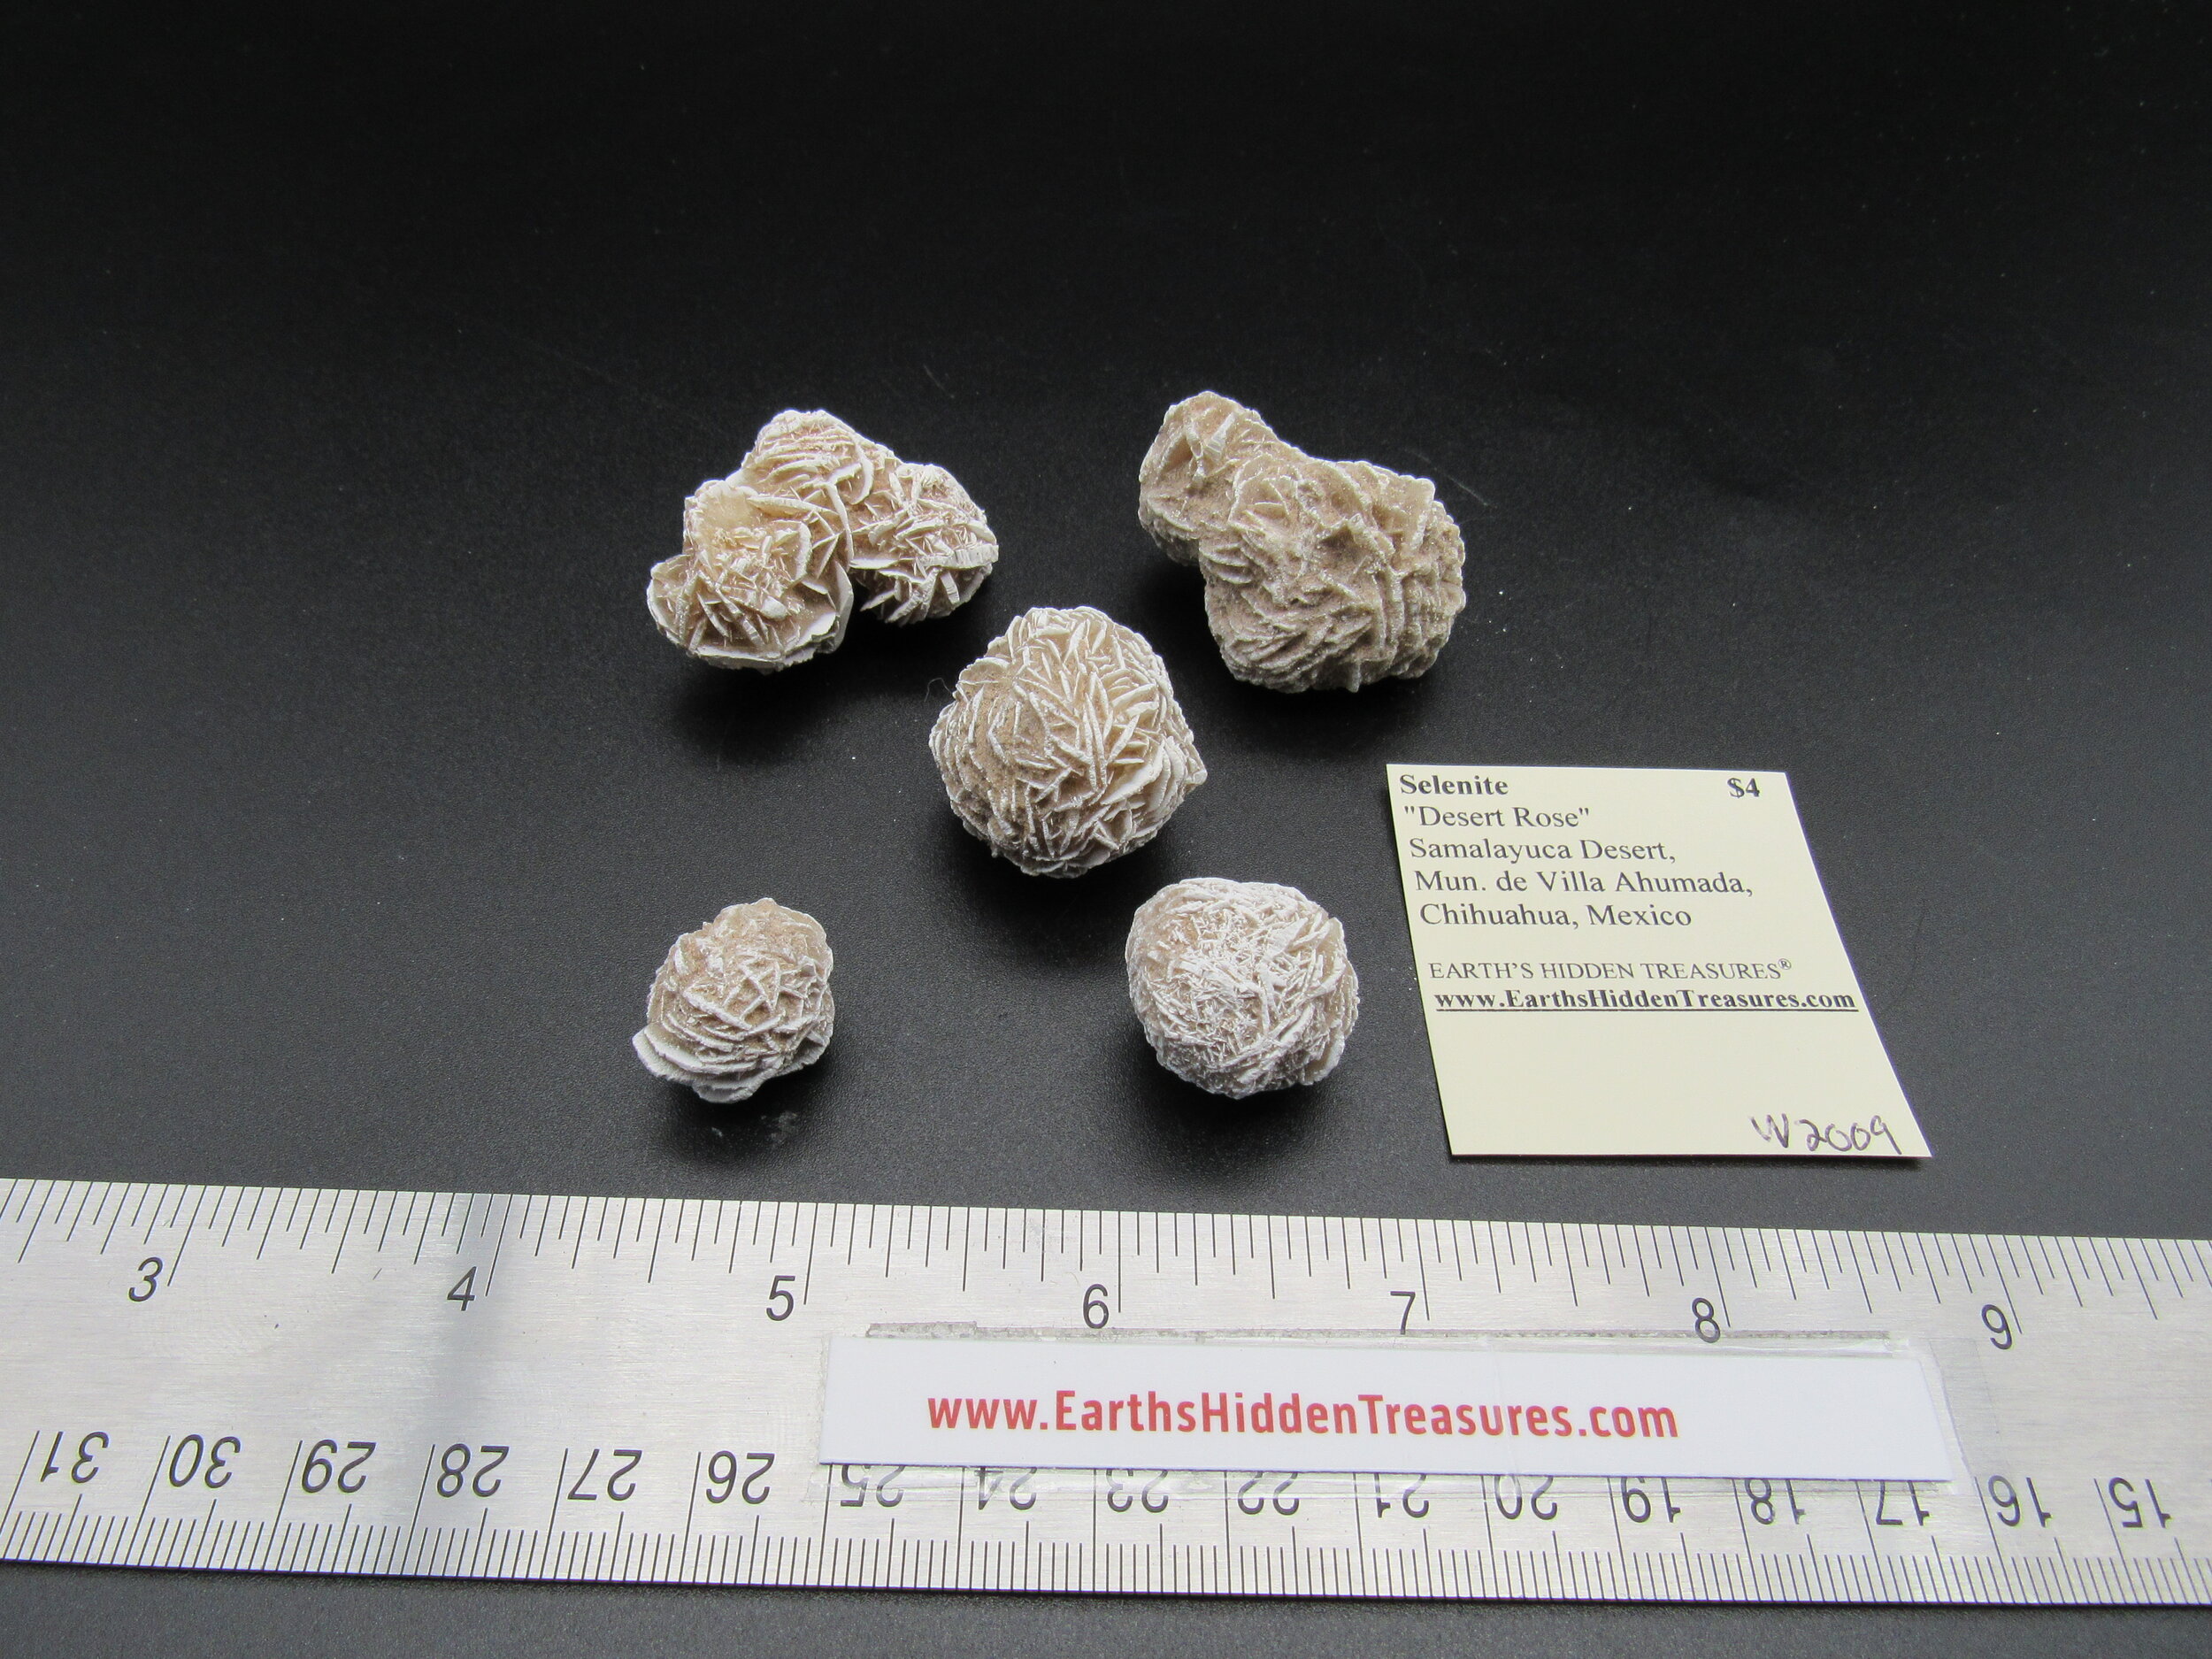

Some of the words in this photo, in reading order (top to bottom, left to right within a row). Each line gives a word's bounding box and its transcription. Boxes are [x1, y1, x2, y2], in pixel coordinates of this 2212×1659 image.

[1399, 774, 1509, 796] Selenite
[1727, 776, 1761, 799] $4
[1404, 805, 1505, 827] "Desert
[1513, 806, 1590, 828] Rose"
[1409, 837, 1572, 864] Samalayuca
[1580, 839, 1677, 863] Desert,
[1415, 871, 1486, 892] Mun.
[1496, 871, 1528, 892] de
[1536, 871, 1606, 893] Villa
[1615, 872, 1754, 896] Ahumada,
[1419, 903, 1579, 930] Chihuahua,
[1586, 903, 1693, 927] Mexico
[1540, 962, 1634, 979] HIDDEN
[1434, 989, 1859, 1012] www.EarthsHiddenTreasures.com
[128, 1256, 163, 1302] 3
[447, 1265, 477, 1311] 4
[765, 1275, 795, 1320] 5
[1082, 1283, 1110, 1330] 6
[1389, 1291, 1417, 1335] 7
[1691, 1297, 1721, 1343] 8
[1981, 1304, 2014, 1349] 9
[927, 1389, 1678, 1438] www.EarthsHiddenTreasures.com
[40, 1431, 109, 1484] 31
[169, 1433, 241, 1488] 30
[301, 1439, 377, 1494] 29
[436, 1443, 510, 1498] 28
[568, 1448, 642, 1502] 27
[706, 1451, 776, 1504] 26
[1986, 1475, 2052, 1528] 16
[2108, 1477, 2172, 1530] 15
